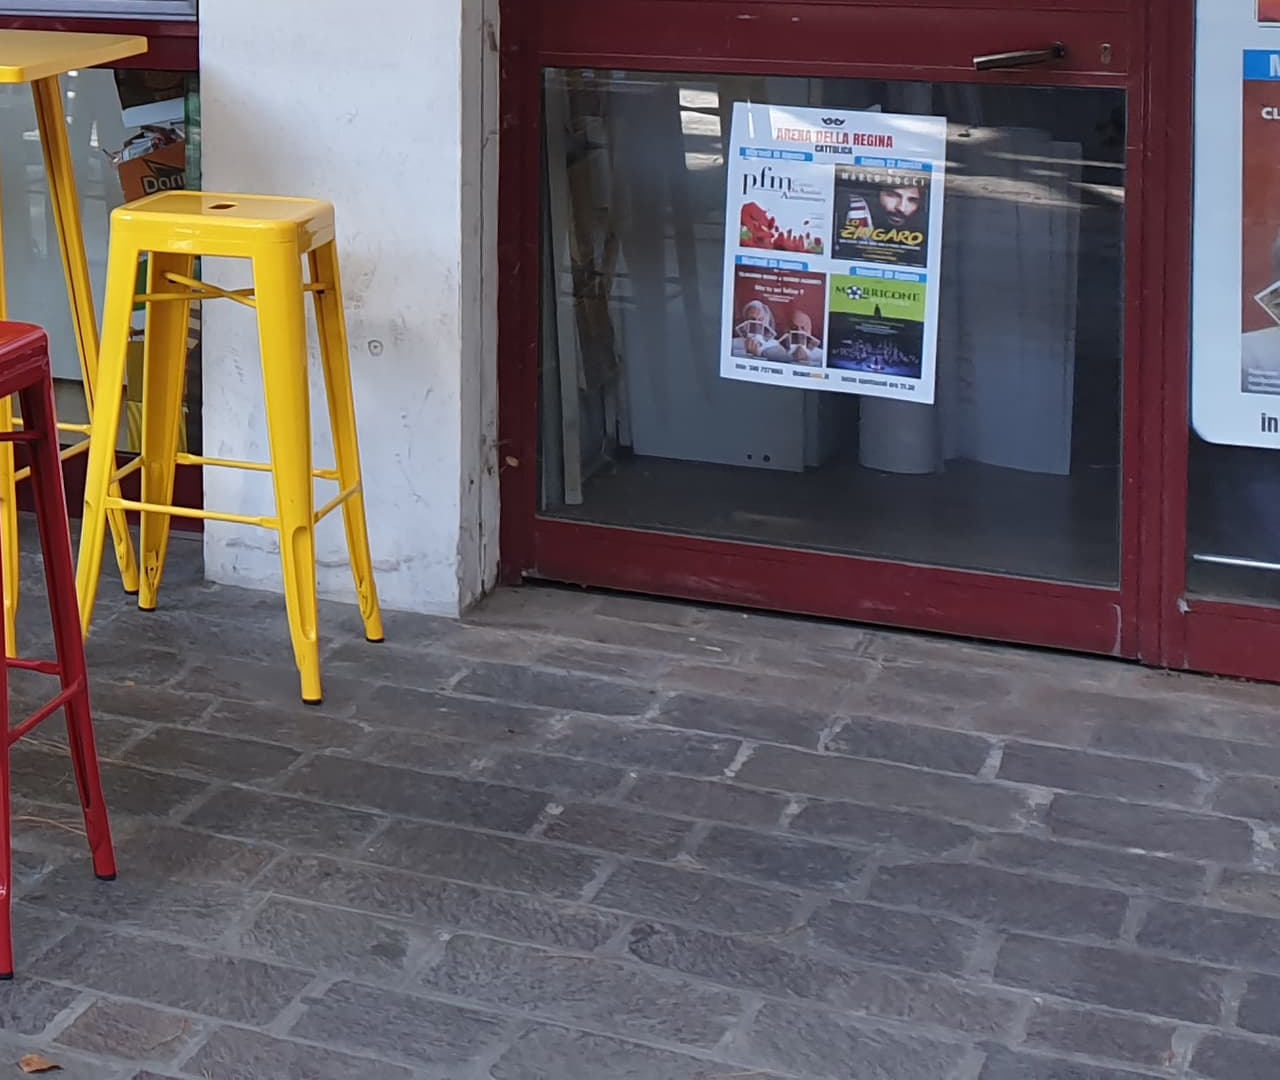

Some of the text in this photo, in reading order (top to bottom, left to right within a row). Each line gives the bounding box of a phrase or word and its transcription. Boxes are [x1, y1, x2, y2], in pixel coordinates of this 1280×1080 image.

[776, 127, 894, 149] ARENA DELLA REGINA
[815, 144, 853, 155] CATTOLICA
[840, 226, 924, 246] ZINGARO
